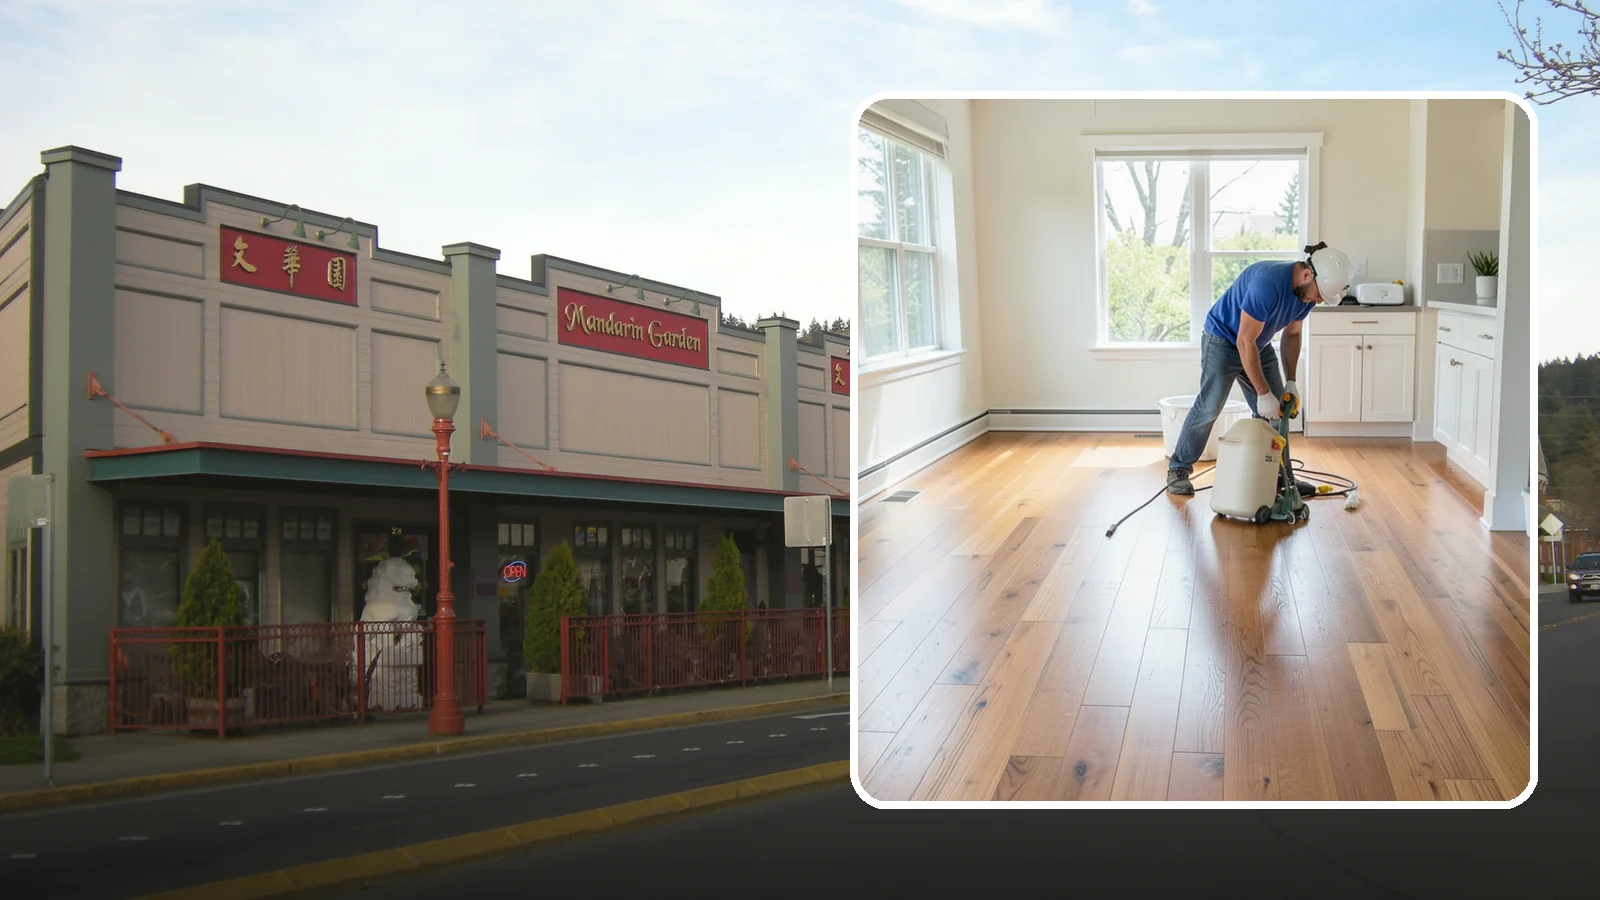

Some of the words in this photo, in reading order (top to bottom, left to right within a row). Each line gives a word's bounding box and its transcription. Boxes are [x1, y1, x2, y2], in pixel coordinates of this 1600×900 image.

[231, 236, 346, 291] 文華園
[564, 302, 644, 341] Mandarin
[648, 320, 701, 352] Garden
[503, 565, 527, 578] OPEN
